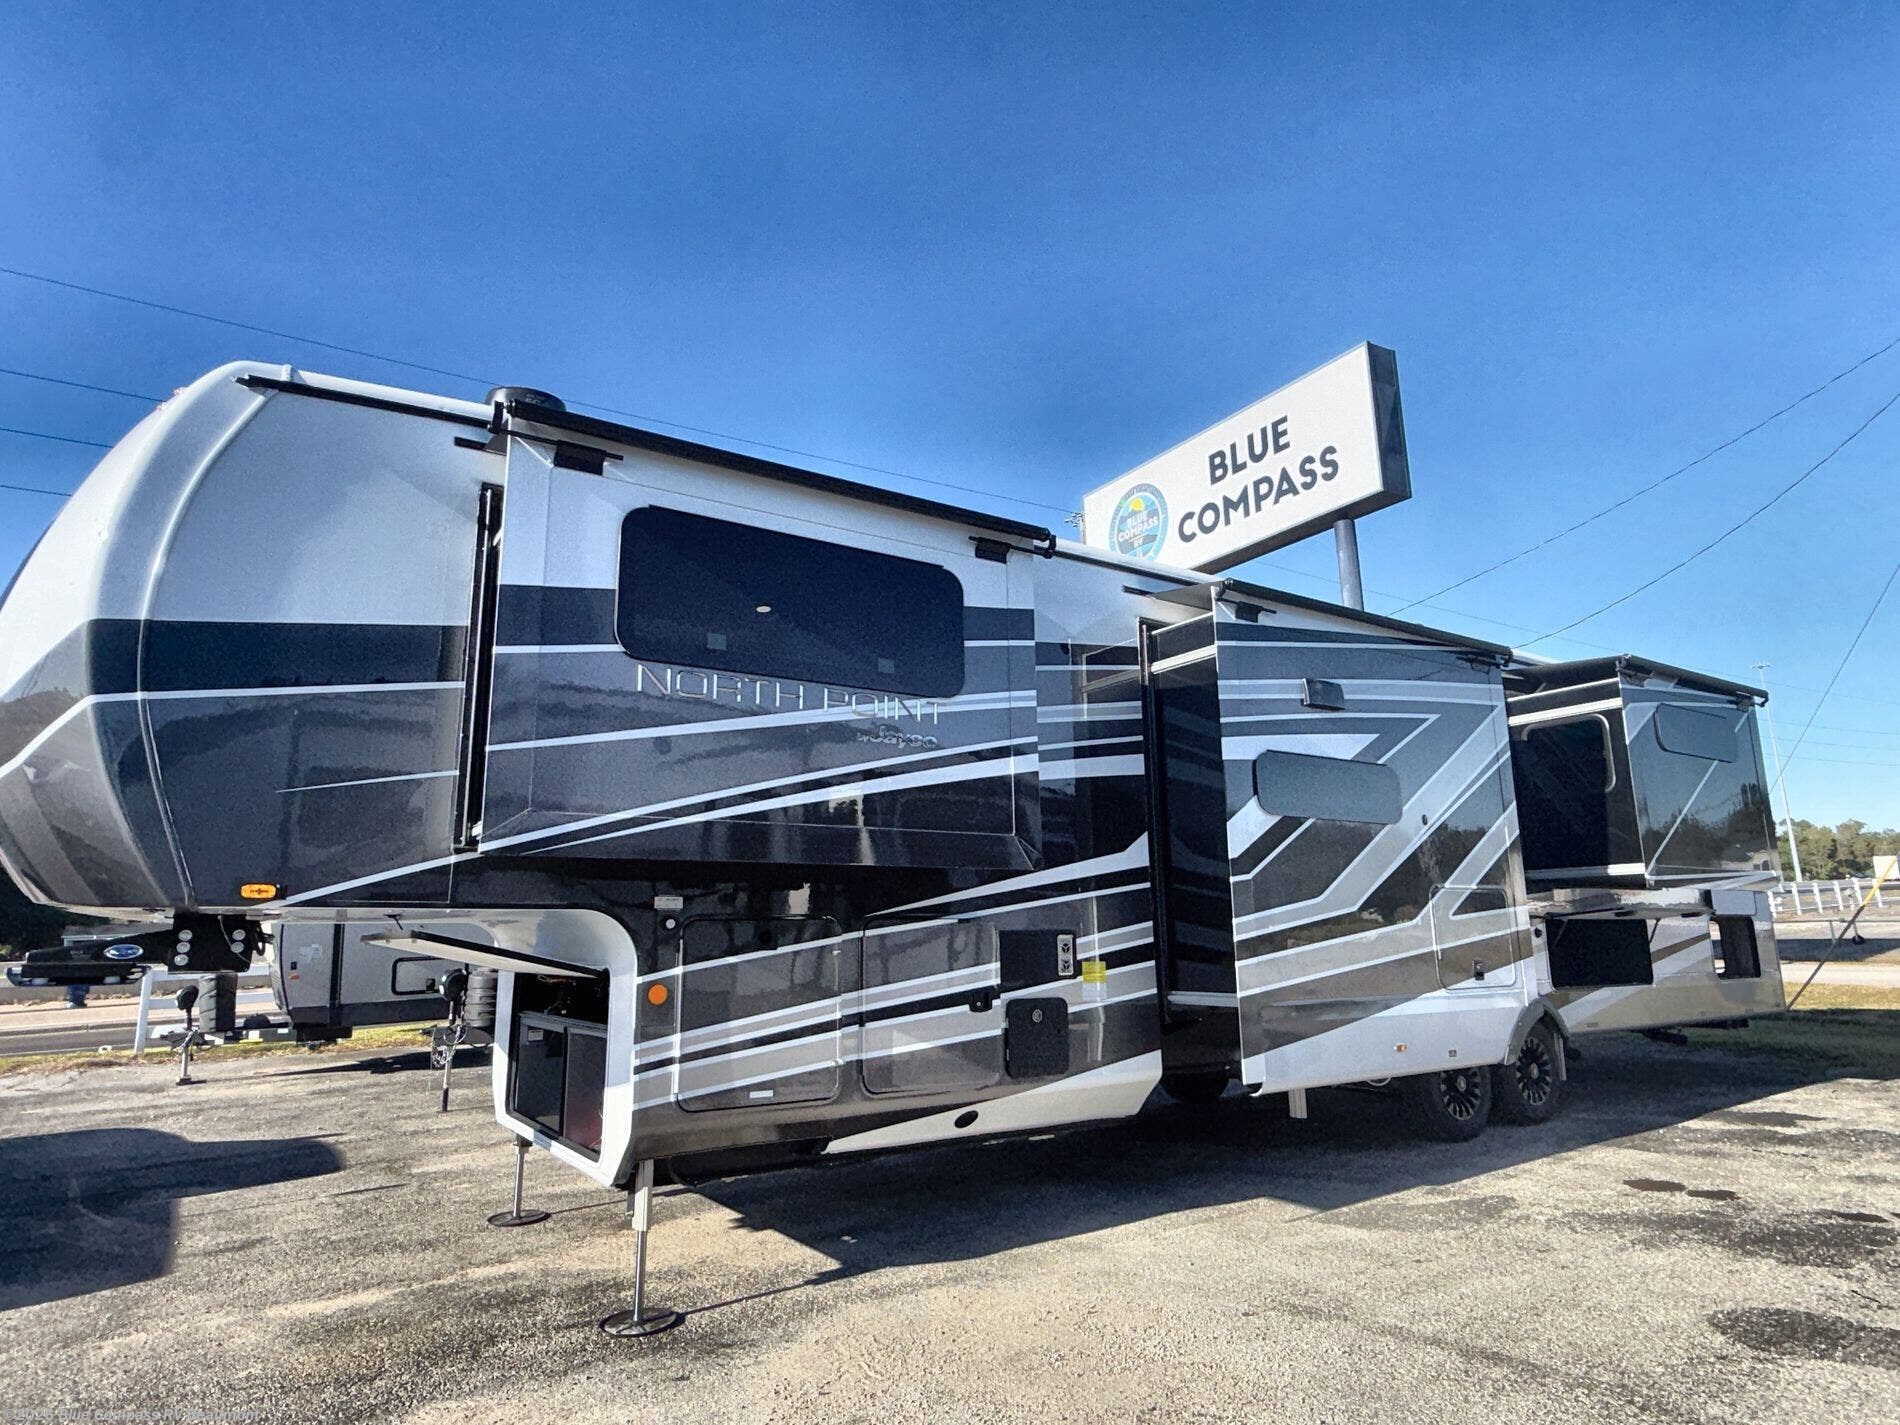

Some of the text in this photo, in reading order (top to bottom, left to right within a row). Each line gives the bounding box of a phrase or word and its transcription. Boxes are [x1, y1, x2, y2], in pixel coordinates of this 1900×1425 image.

[1208, 415, 1291, 486] BLUE
[1178, 445, 1339, 543] COMPASS
[1118, 515, 1159, 542] COMPASS
[1127, 510, 1149, 528] BLUE
[637, 664, 947, 725] NORTH POINT
[869, 725, 938, 749] Jayco
